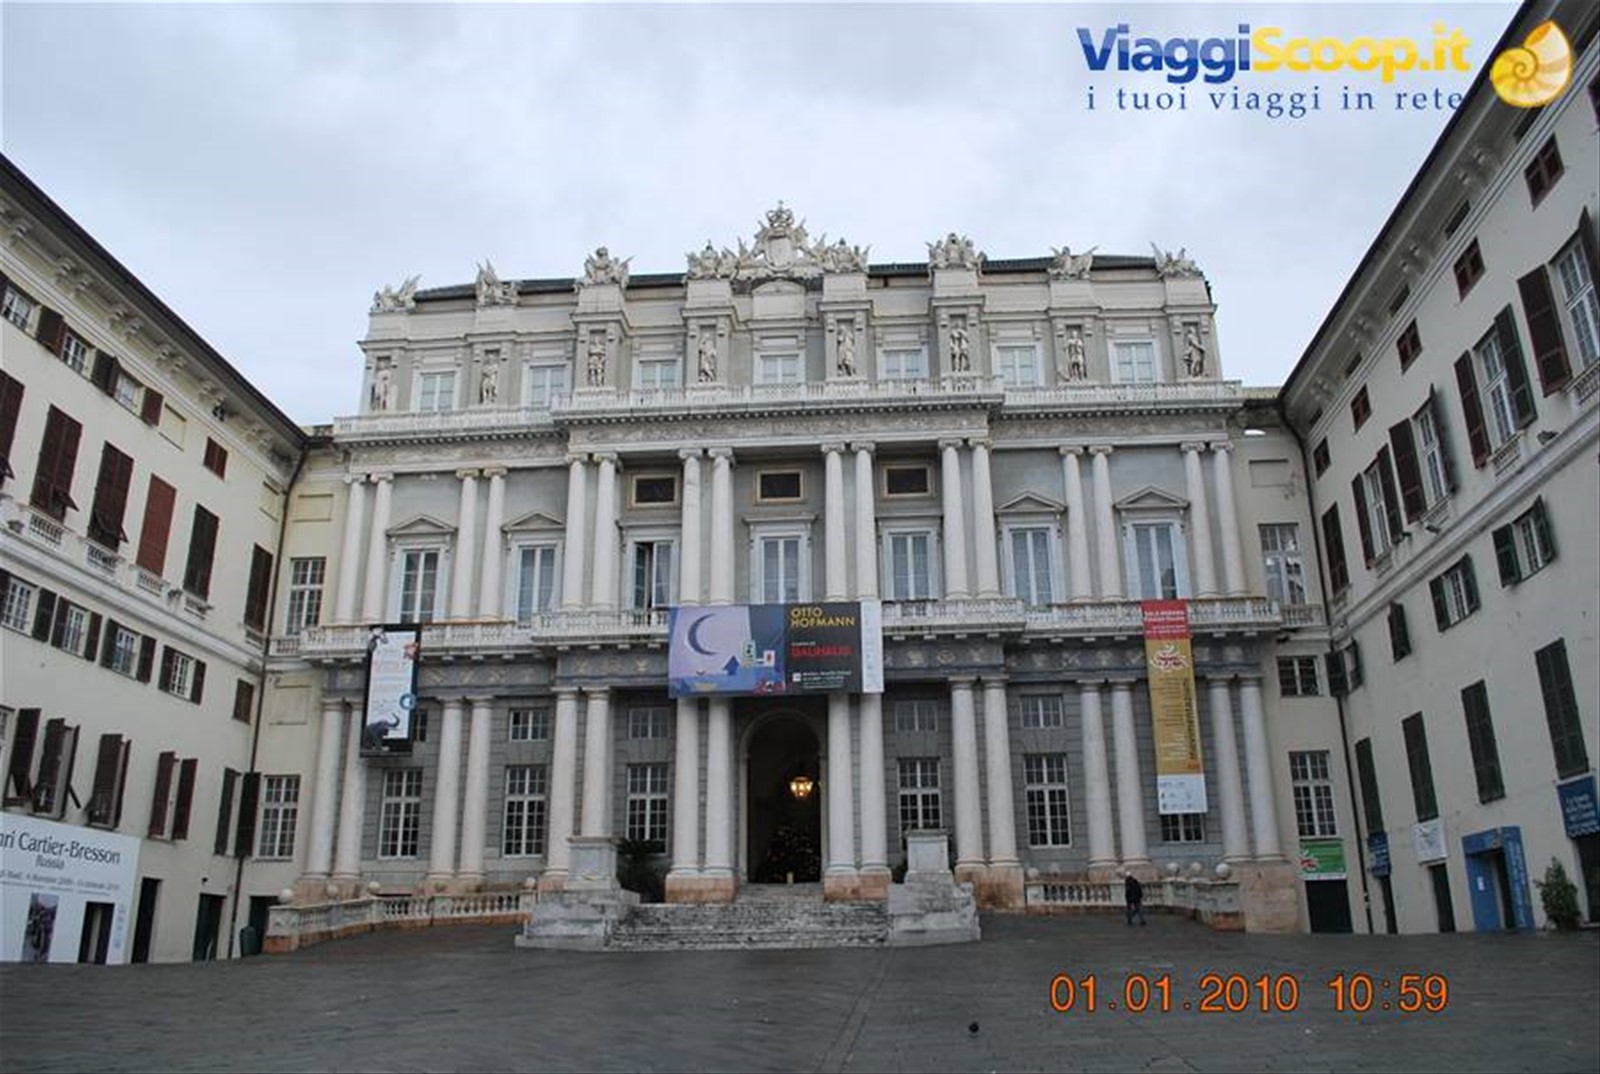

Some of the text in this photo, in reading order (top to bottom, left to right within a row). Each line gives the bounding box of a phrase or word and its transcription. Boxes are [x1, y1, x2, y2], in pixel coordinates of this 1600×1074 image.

[791, 607, 823, 618] OTTO
[791, 616, 855, 628] HOFMANN
[18, 831, 121, 865] Cartier-Bresson
